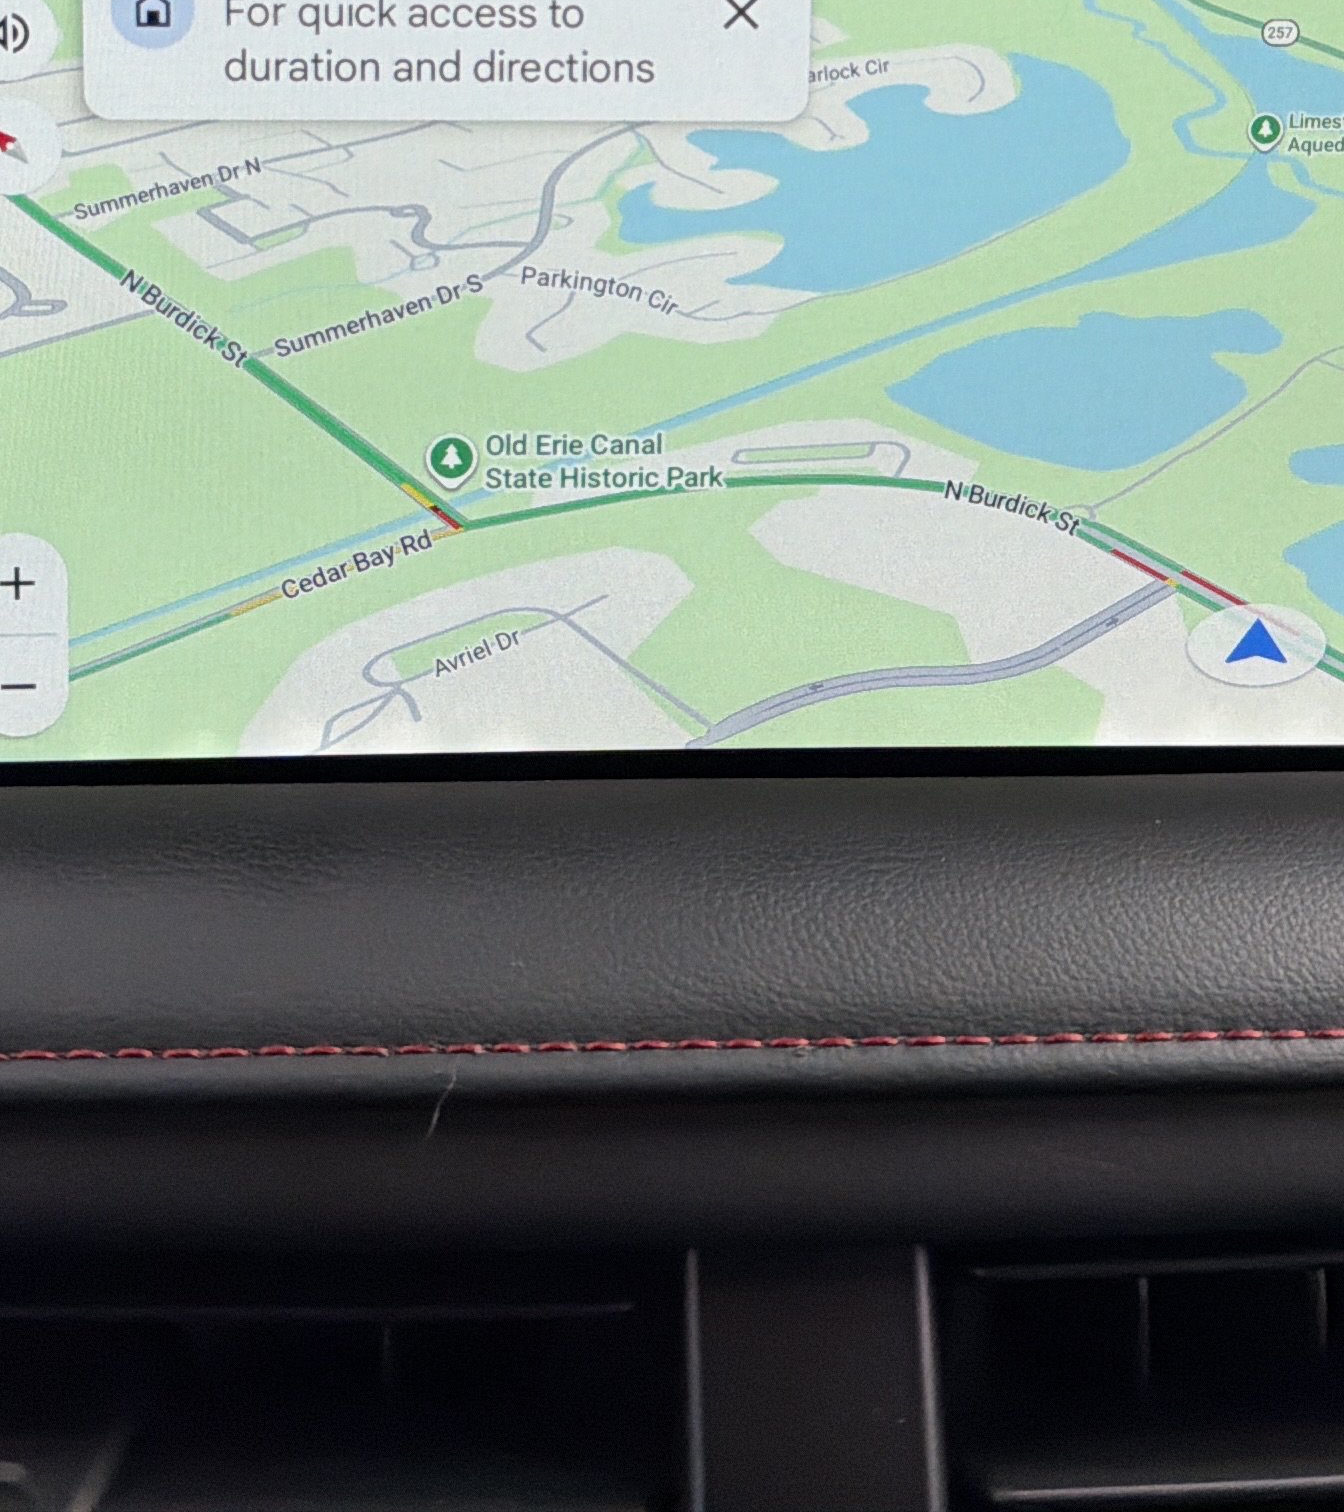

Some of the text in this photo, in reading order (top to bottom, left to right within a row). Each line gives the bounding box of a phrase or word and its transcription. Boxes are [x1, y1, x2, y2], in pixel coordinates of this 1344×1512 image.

[407, 3, 537, 29] access
[1267, 26, 1294, 39] 257
[224, 49, 656, 84] duration and directions
[808, 58, 890, 83] arlock Cir
[73, 157, 262, 220] Summerhaven Dr N
[273, 274, 484, 358] Summerhaven Dr S
[520, 266, 679, 317] Parkington Cir
[119, 269, 248, 368] N Burdick St
[485, 433, 663, 457] Old Erie Canal
[485, 466, 724, 490] State Historic Park
[944, 480, 1080, 536] N Burdick St
[280, 529, 433, 600] Cedar Bay Rd
[433, 628, 522, 678] Avriel Dr
